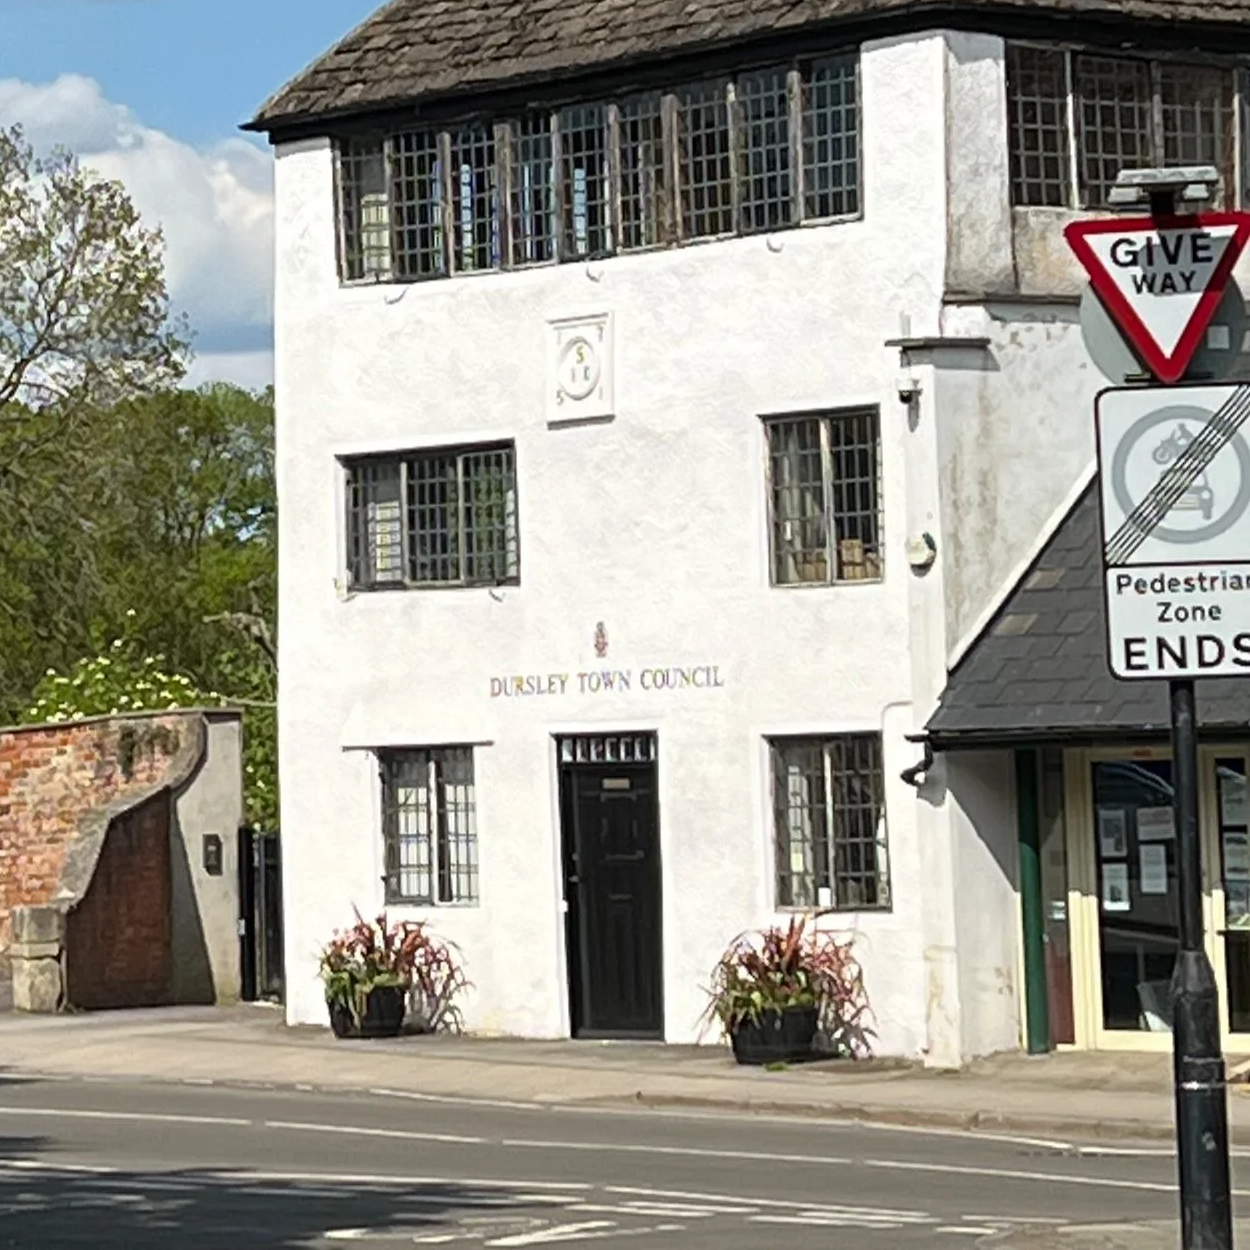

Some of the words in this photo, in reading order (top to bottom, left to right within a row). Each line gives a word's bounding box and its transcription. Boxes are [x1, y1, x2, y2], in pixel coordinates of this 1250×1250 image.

[1110, 232, 1213, 267] GIVE
[1132, 270, 1198, 295] WAY
[1156, 601, 1222, 623] Zone
[1123, 632, 1250, 670] ENDS
[490, 672, 569, 697] DURSLEY
[577, 669, 631, 693] TOWN
[640, 665, 724, 690] COUNCIL
